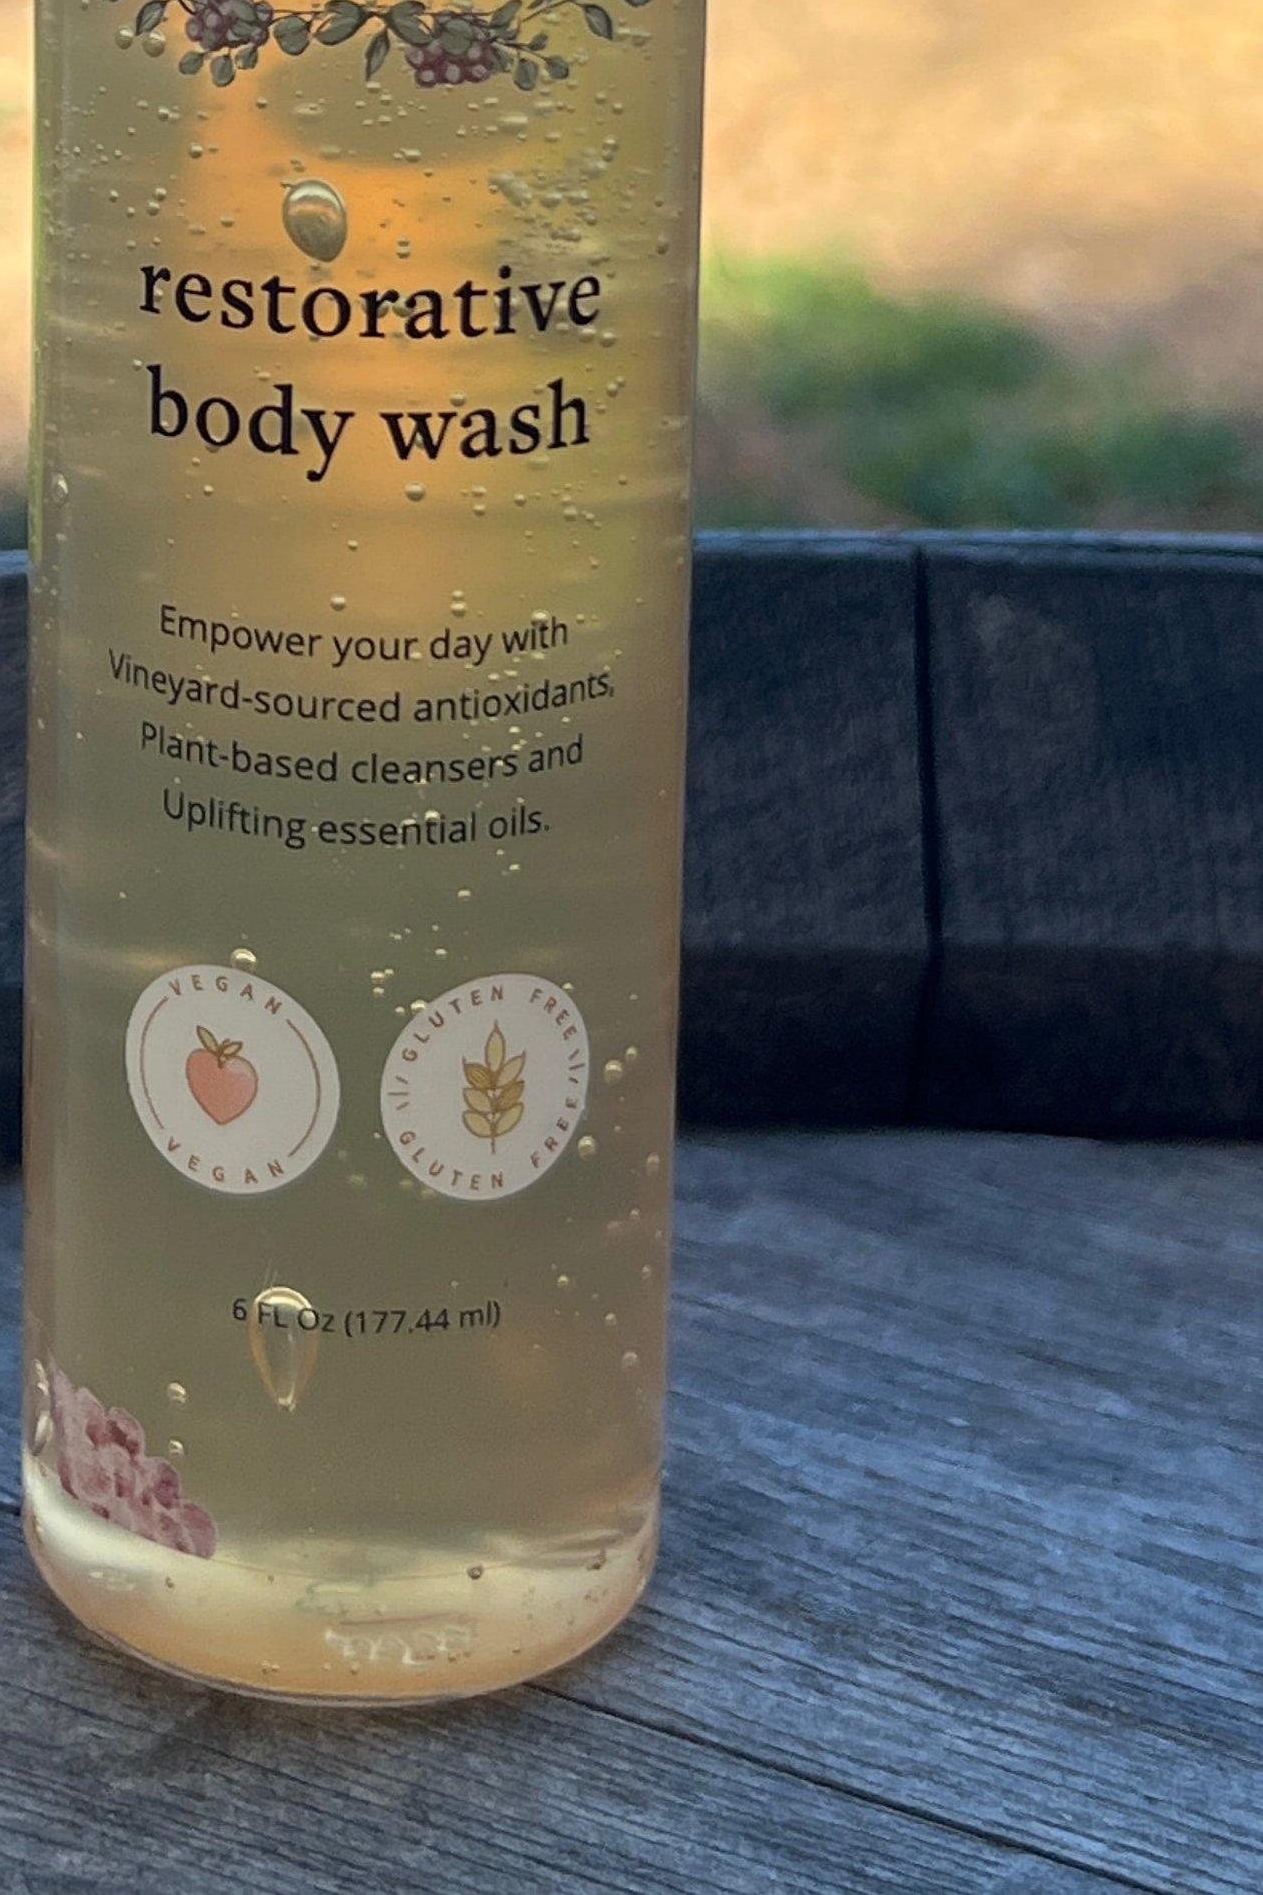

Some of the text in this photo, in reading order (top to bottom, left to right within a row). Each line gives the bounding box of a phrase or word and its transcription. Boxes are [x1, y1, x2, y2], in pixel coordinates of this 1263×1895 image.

[139, 264, 601, 339] restorative
[146, 364, 591, 482] body wash
[159, 604, 568, 667] Empower your day with
[109, 649, 615, 723] Vineyard-sourced antioxidants,
[140, 721, 584, 785] Plant-based cleansers and
[162, 788, 550, 849] Uplifting essential oils.
[168, 974, 283, 1015] VEGAN
[402, 985, 578, 1062] GLUTEN FREE
[166, 1138, 284, 1184] VEGAN
[400, 1096, 578, 1190] GLUTEN FREE
[232, 1298, 501, 1337] 6 FL Oz (177.44 ml)
